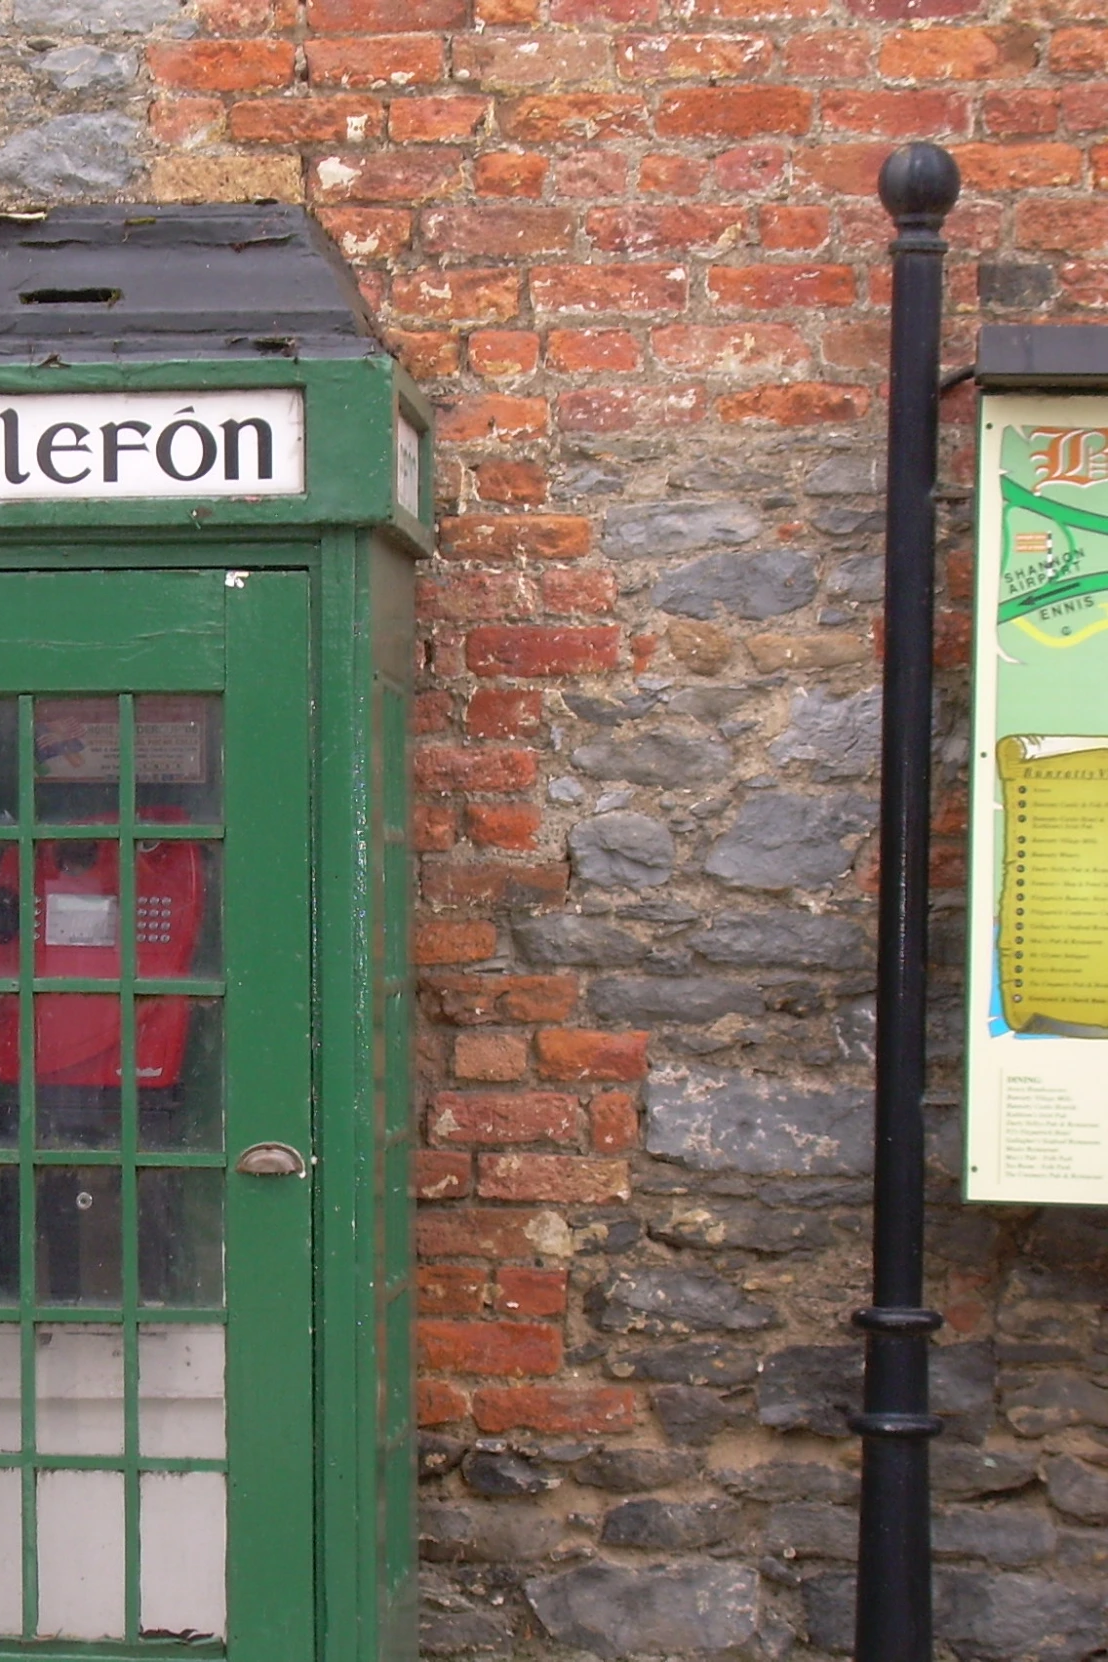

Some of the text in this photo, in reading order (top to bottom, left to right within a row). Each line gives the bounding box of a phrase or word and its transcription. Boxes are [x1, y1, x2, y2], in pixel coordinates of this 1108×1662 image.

[1003, 546, 1085, 584] SHANNON
[1008, 561, 1081, 594] AIRPORT
[1039, 595, 1095, 621] ENNIS
